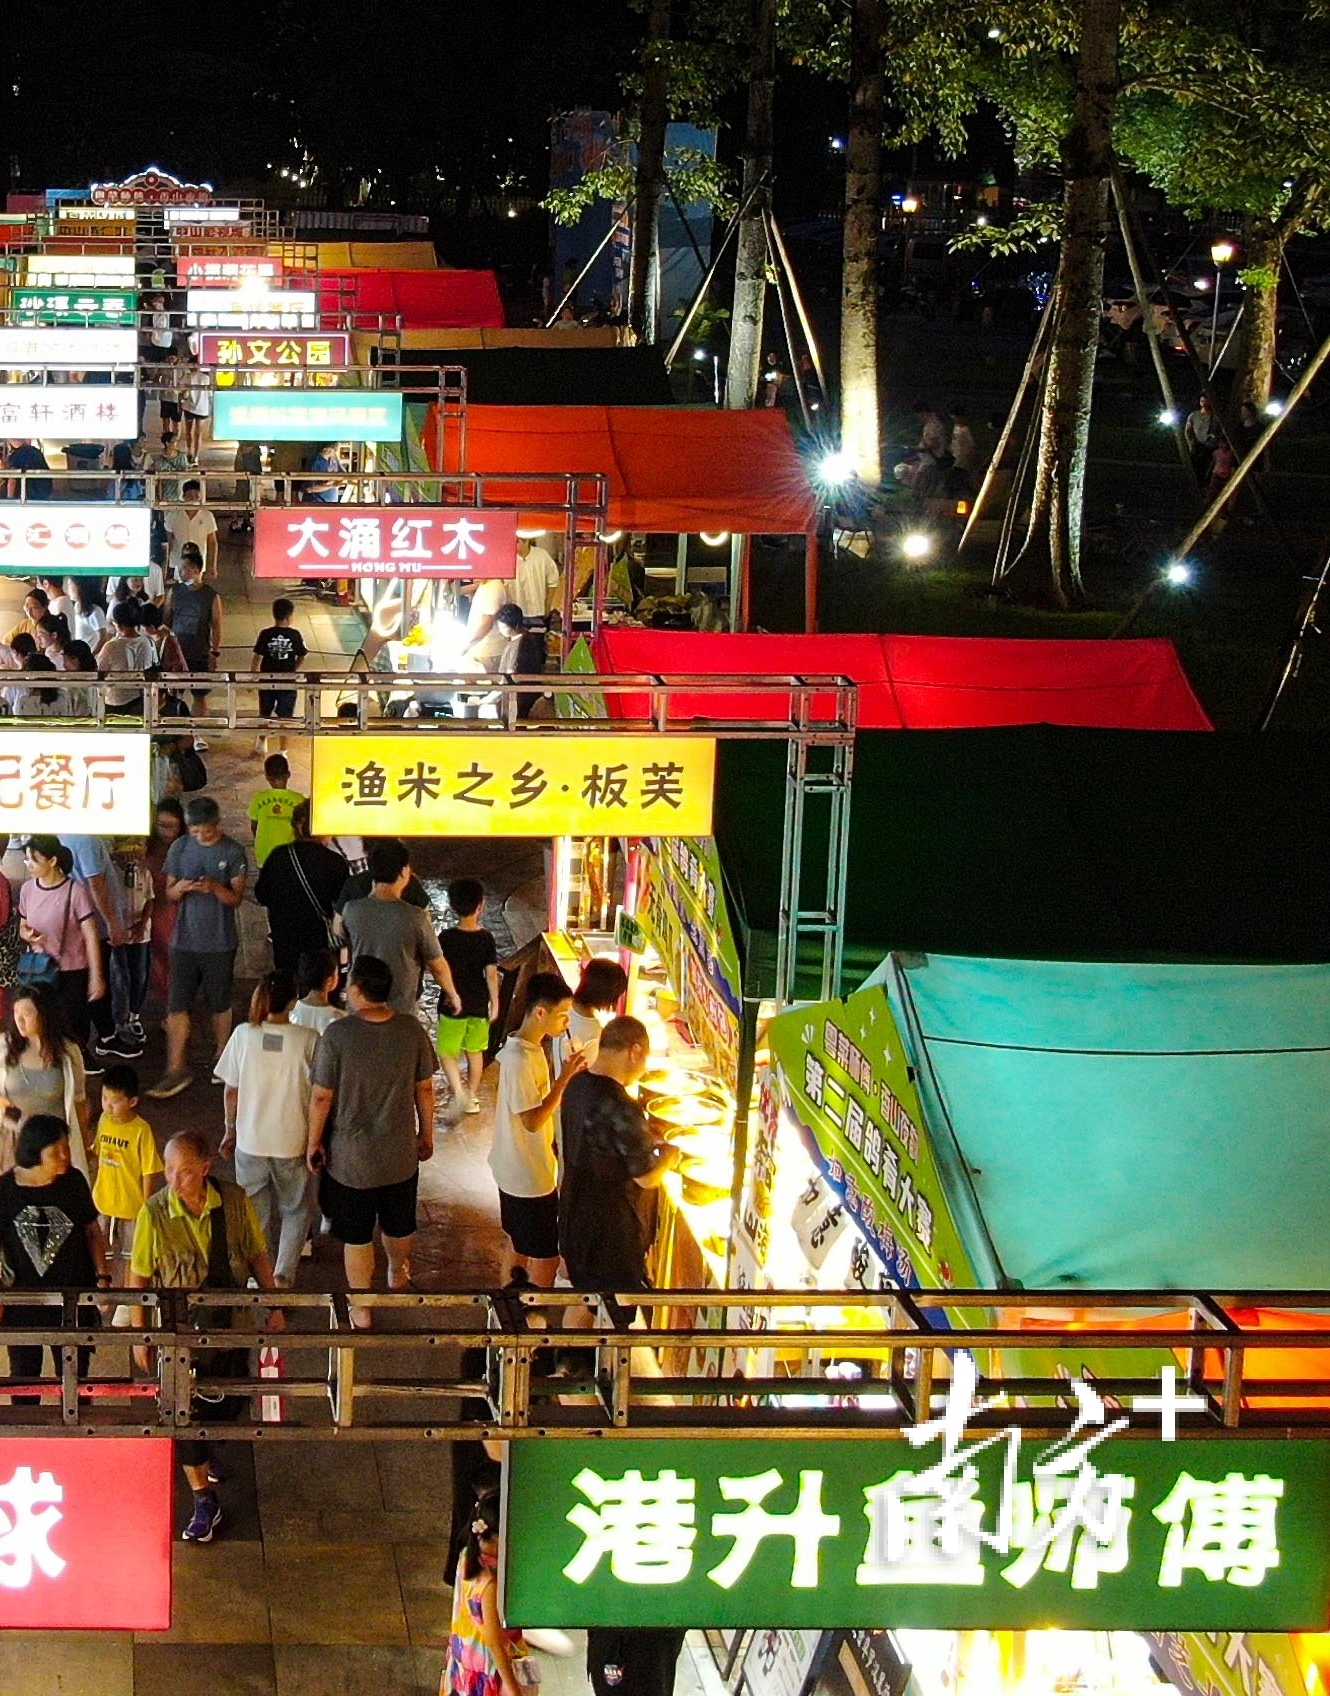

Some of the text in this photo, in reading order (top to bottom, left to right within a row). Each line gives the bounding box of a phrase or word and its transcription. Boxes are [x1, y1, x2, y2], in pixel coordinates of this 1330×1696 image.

[217, 340, 331, 366] 孙文公园
[286, 517, 486, 560] 大涌红木
[351, 562, 423, 573] HONG MU
[341, 761, 685, 809] 渔米之乡·板芙
[562, 1468, 1285, 1589] 港升鱼师傅
